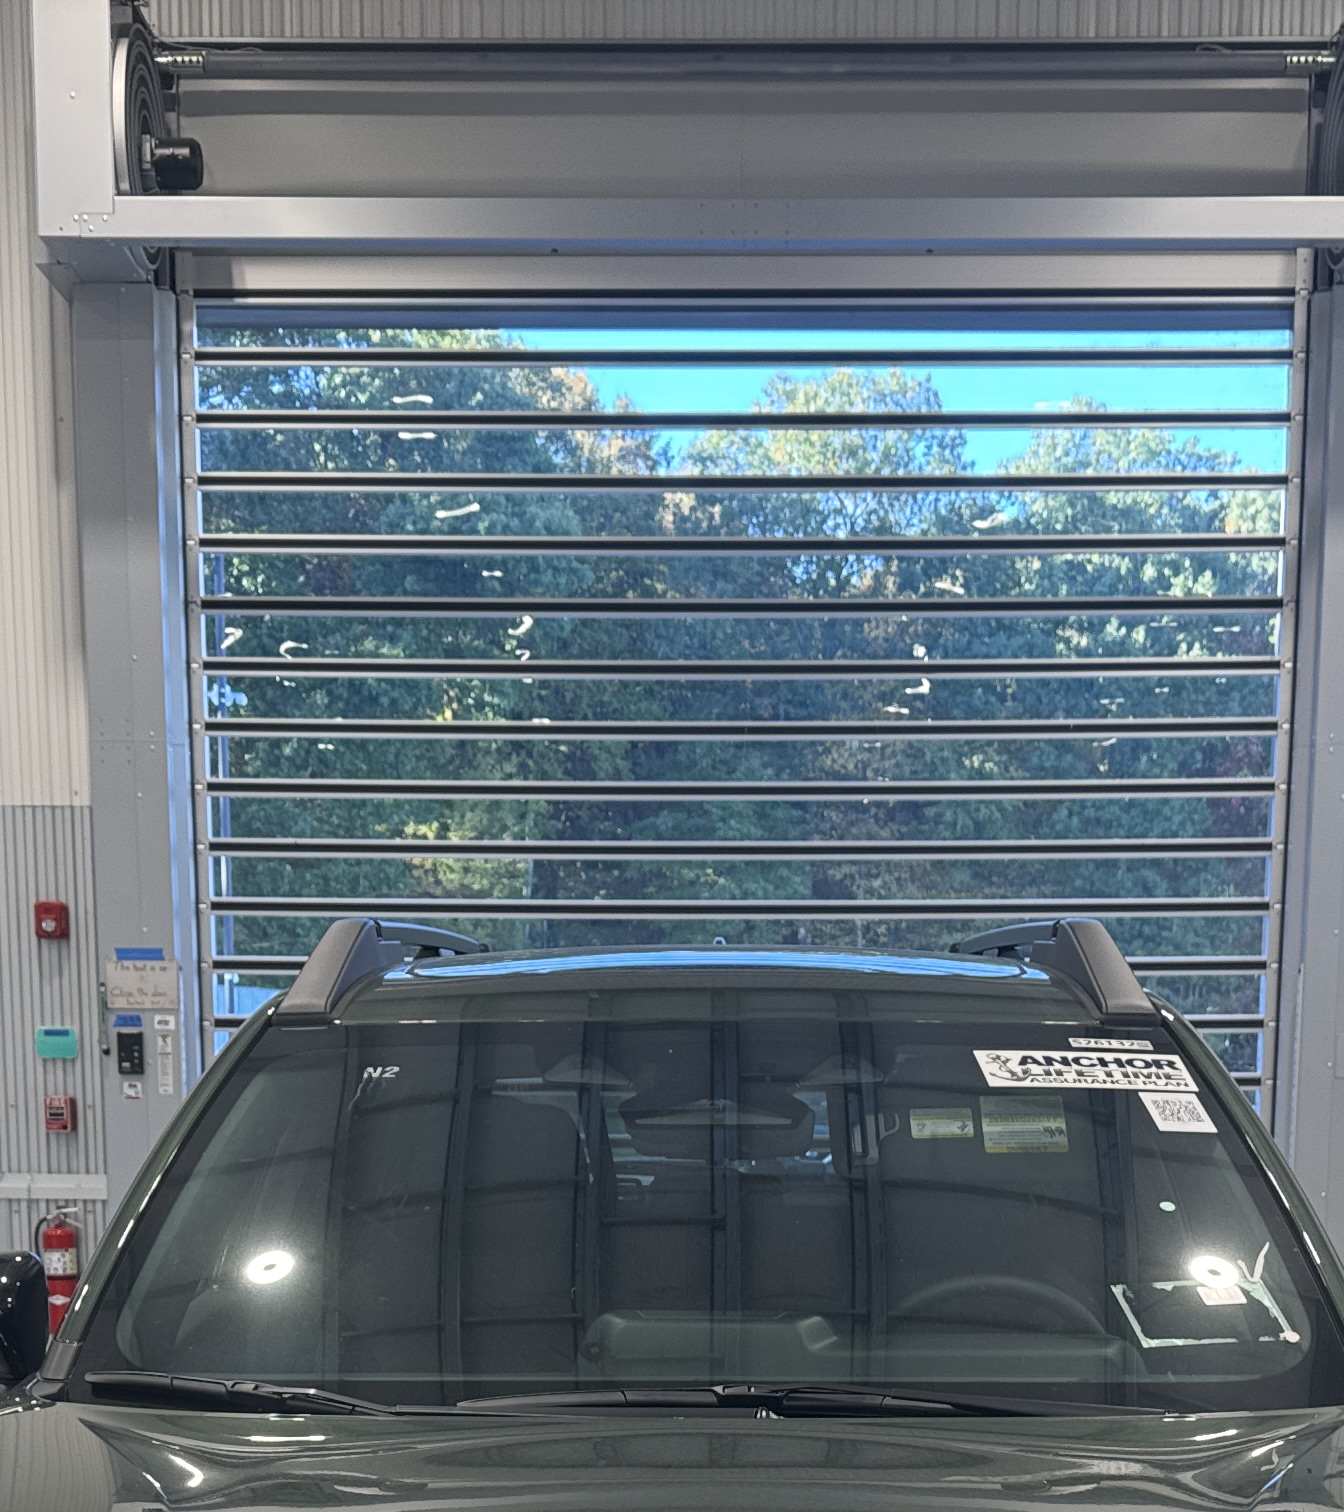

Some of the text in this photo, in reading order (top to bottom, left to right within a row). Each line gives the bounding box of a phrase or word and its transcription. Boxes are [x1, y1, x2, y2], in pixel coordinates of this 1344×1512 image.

[1018, 1054, 1182, 1071] ANCHOR
[362, 1065, 400, 1078] N2
[1022, 1067, 1187, 1081] LIFETIME
[1029, 1077, 1190, 1088] ASSURANCE PLAN
